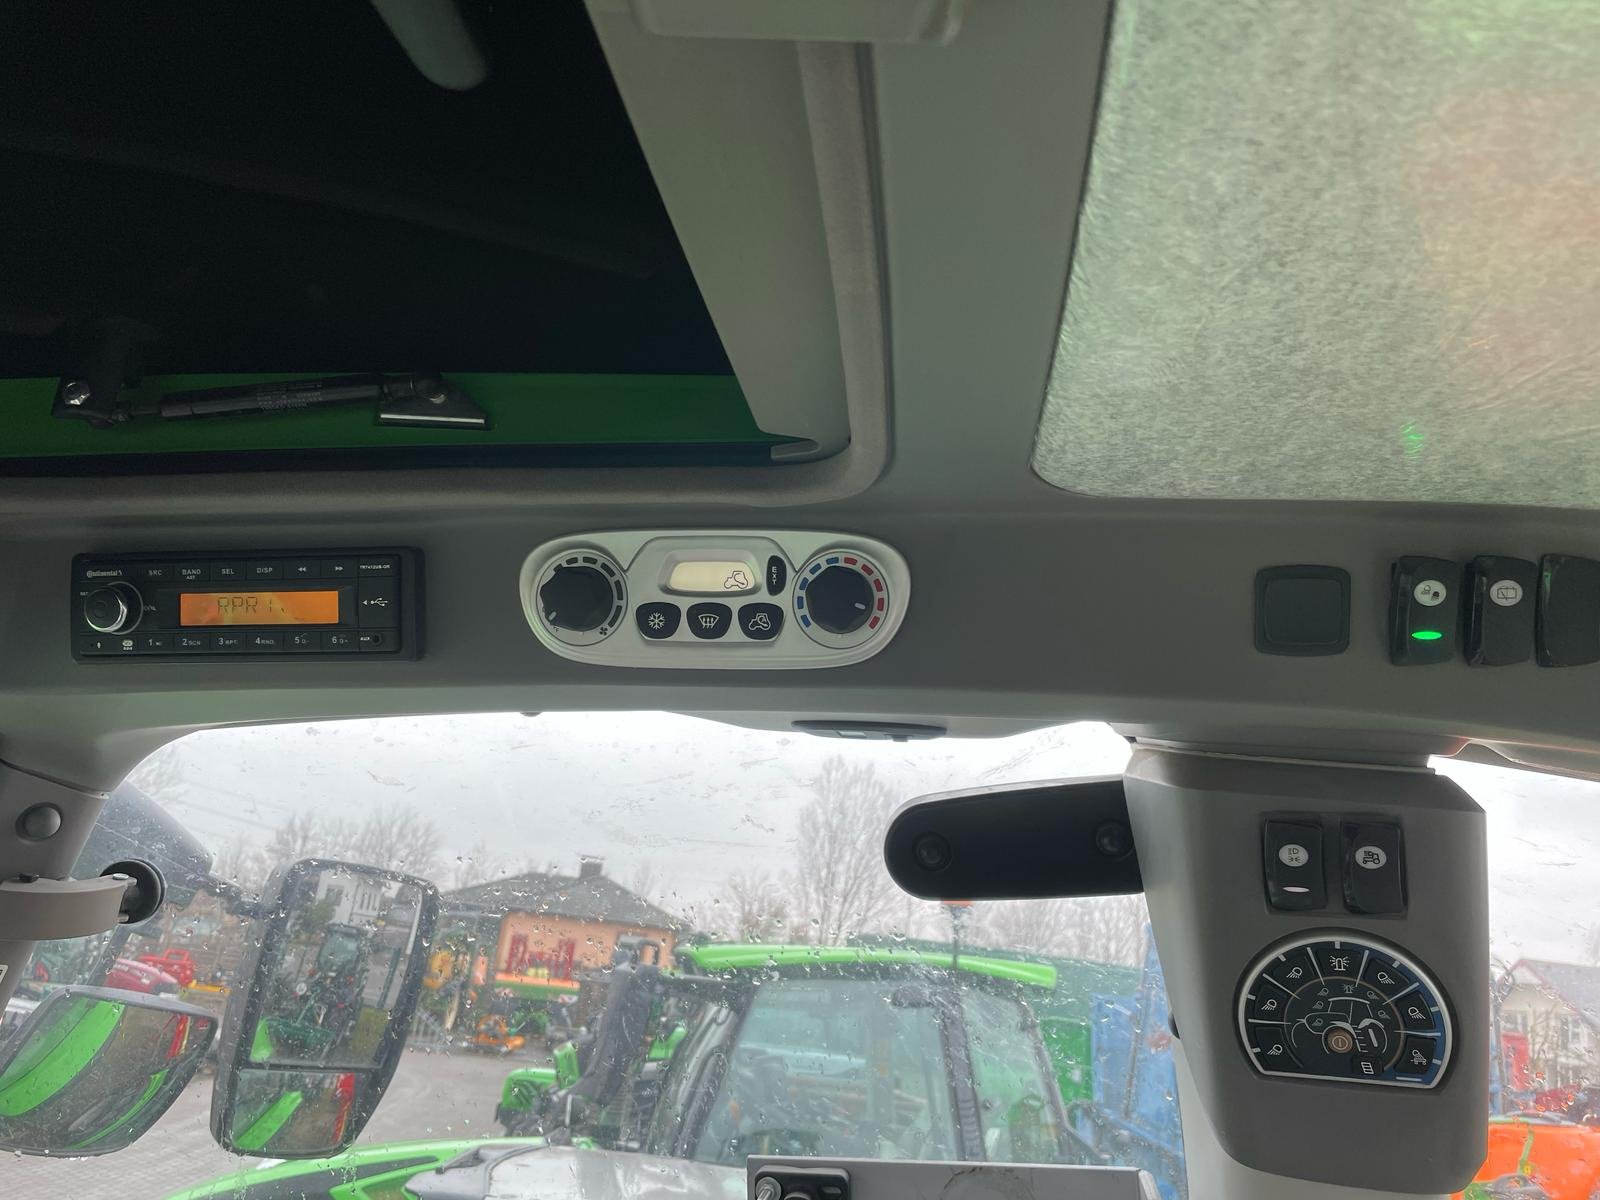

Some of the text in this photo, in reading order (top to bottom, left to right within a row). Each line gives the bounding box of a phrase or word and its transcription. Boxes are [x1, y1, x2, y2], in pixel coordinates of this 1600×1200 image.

[182, 638, 188, 646] 2
[255, 637, 261, 645] 4
[294, 636, 300, 644] 5
[331, 636, 337, 644] 6
